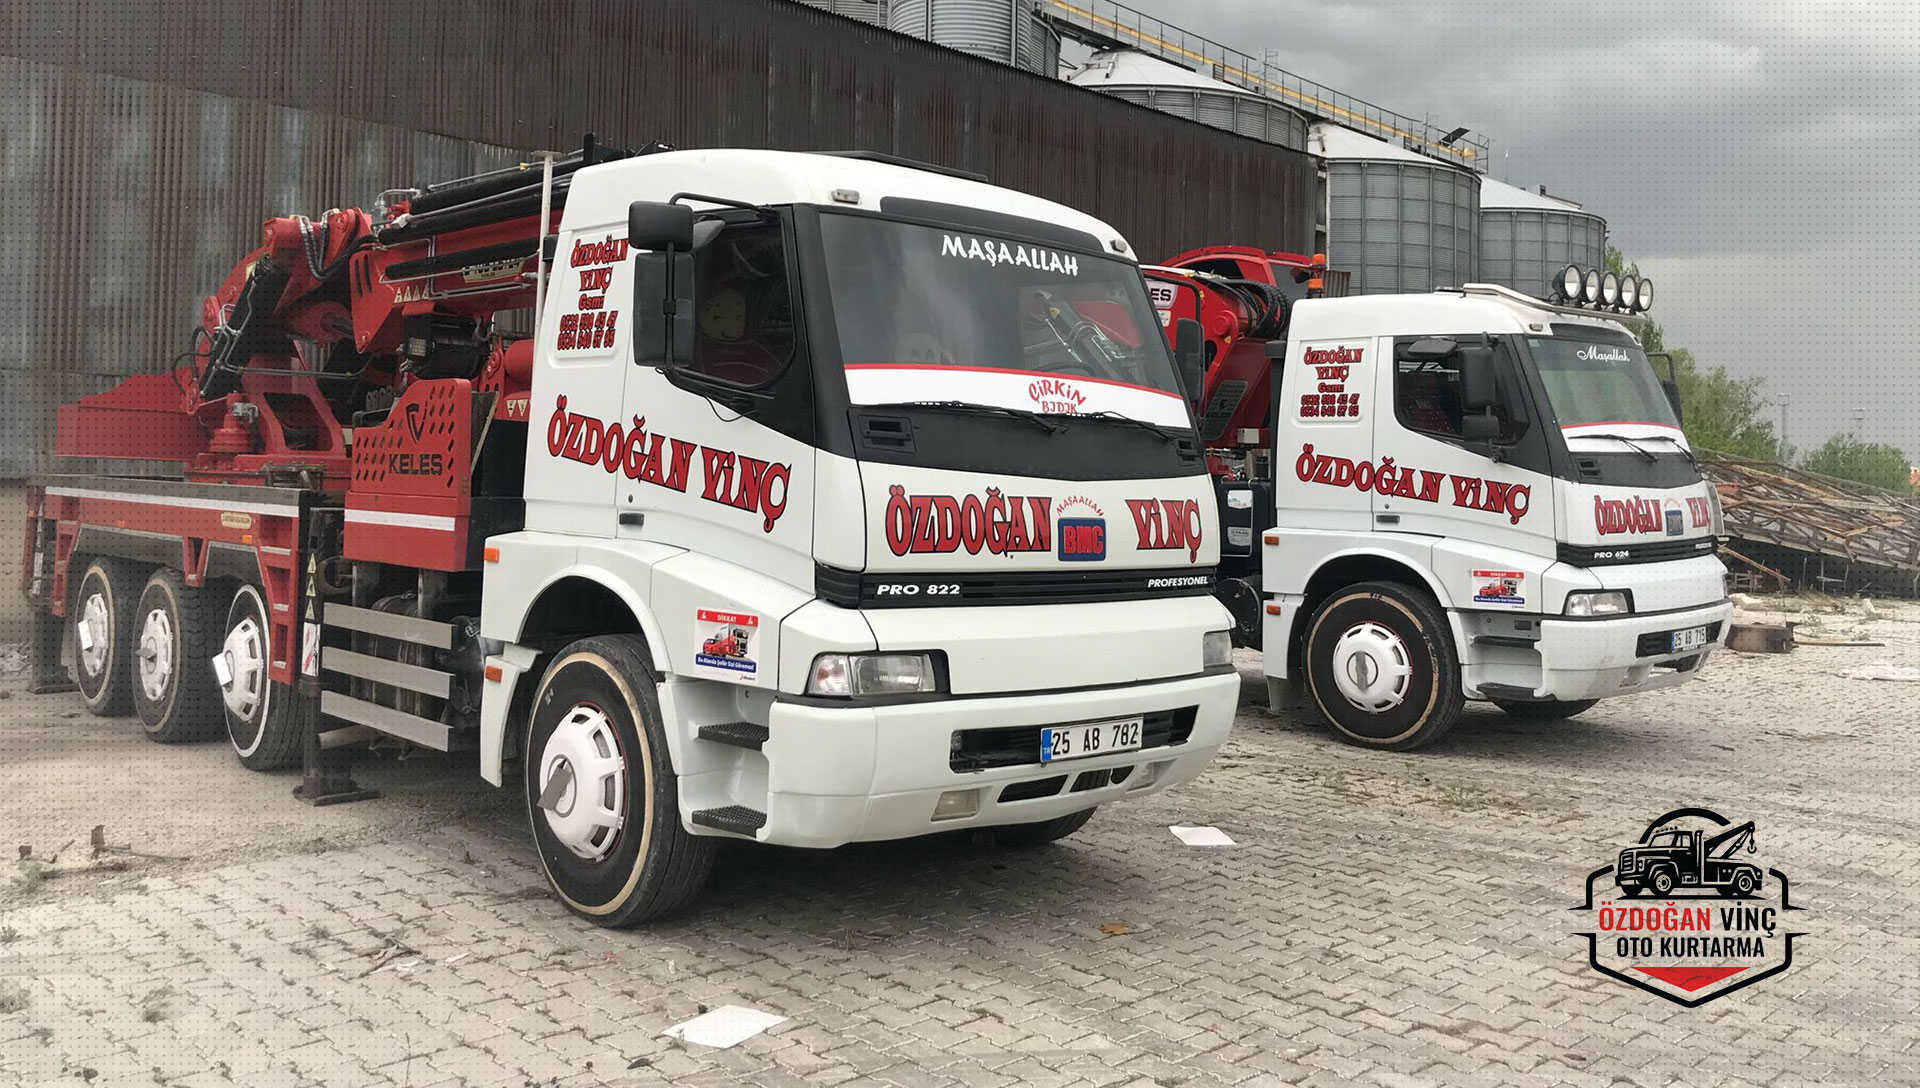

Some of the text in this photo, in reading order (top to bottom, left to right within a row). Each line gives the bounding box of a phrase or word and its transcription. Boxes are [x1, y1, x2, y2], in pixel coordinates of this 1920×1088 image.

[941, 234, 1079, 276] MAŞAALLAH
[547, 394, 698, 494] ÖZDOĞAN
[388, 453, 443, 476] KELES
[1295, 443, 1447, 504] ÖZDOĞAN
[1056, 495, 1104, 516] MAŞAALLAH
[1594, 494, 1663, 536] ÖZDOĞAN
[884, 484, 1053, 558] ÖZDOĞAN
[1063, 524, 1104, 555] BMC
[1594, 550, 1630, 559] PRO 624
[876, 584, 961, 596] PRO 822
[1147, 576, 1209, 589] PROFESYONEL
[1674, 632, 1682, 647] 25
[1043, 747, 1051, 755] TR
[1052, 722, 1138, 756] 25 AB 782
